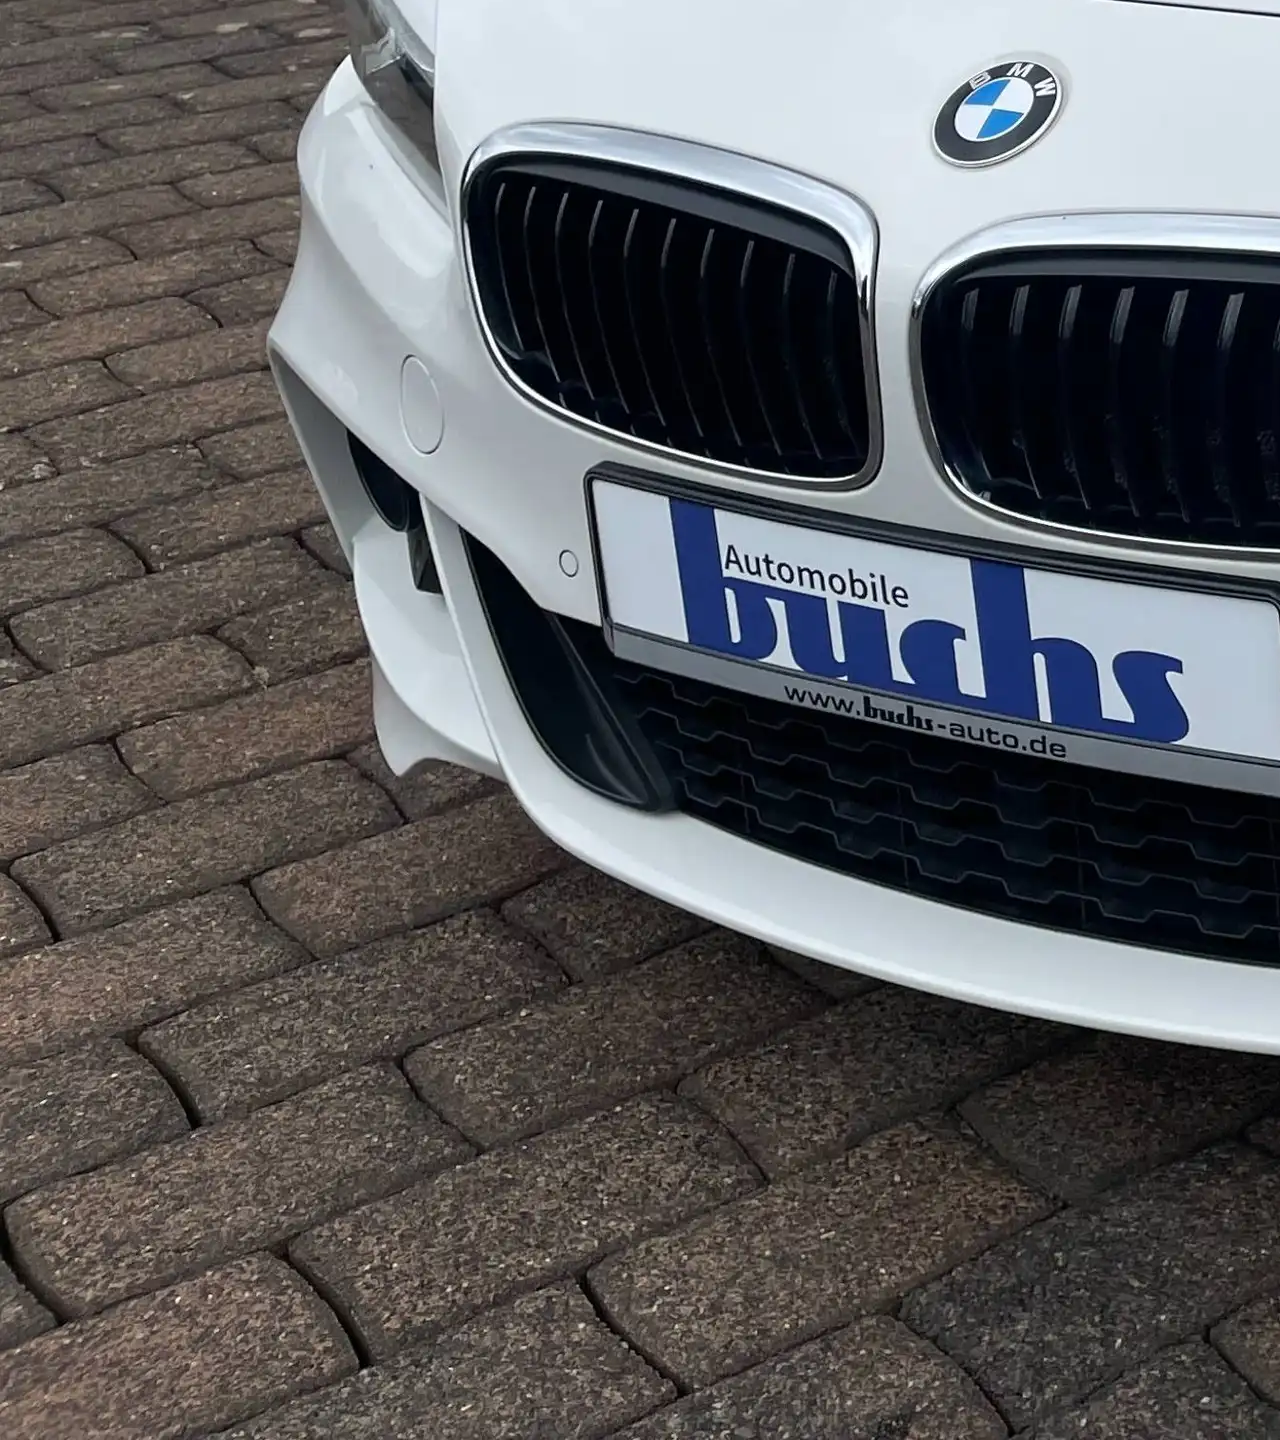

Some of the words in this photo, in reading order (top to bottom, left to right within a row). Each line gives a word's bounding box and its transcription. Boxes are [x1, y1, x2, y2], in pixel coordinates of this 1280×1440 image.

[968, 62, 1057, 97] BMW
[723, 543, 911, 610] Automobile
[669, 496, 1190, 745] buchs
[783, 684, 1068, 760] www.buchs-auto.de
